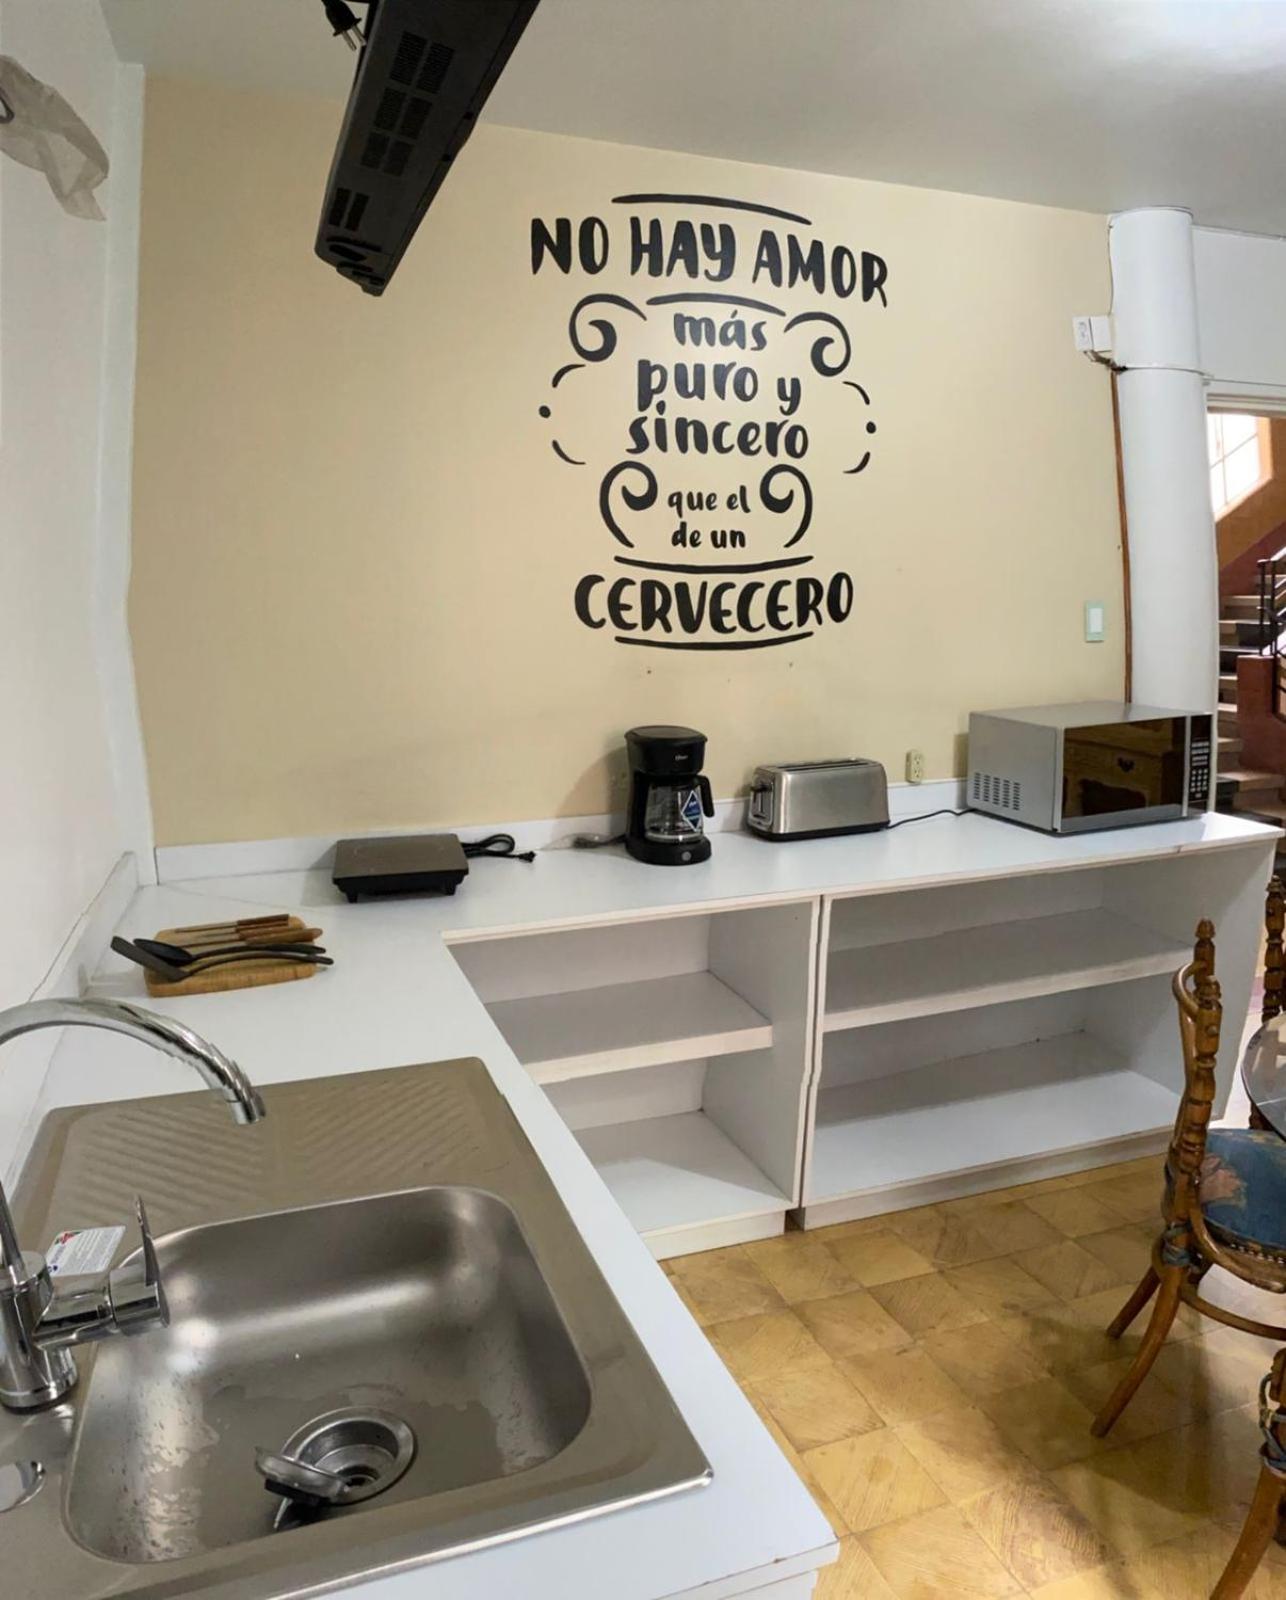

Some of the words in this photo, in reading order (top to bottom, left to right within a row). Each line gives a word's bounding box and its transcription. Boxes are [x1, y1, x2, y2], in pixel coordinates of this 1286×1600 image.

[531, 216, 609, 276] NO
[630, 216, 736, 282] HAY
[752, 230, 888, 308] AMOR
[673, 309, 767, 351] más
[638, 359, 758, 412] puro
[777, 377, 801, 416] y
[626, 400, 809, 459] sincero
[668, 491, 717, 519] que
[726, 485, 751, 514] el
[671, 521, 702, 548] de
[710, 529, 746, 549] un
[574, 571, 854, 635] CERVECERO
